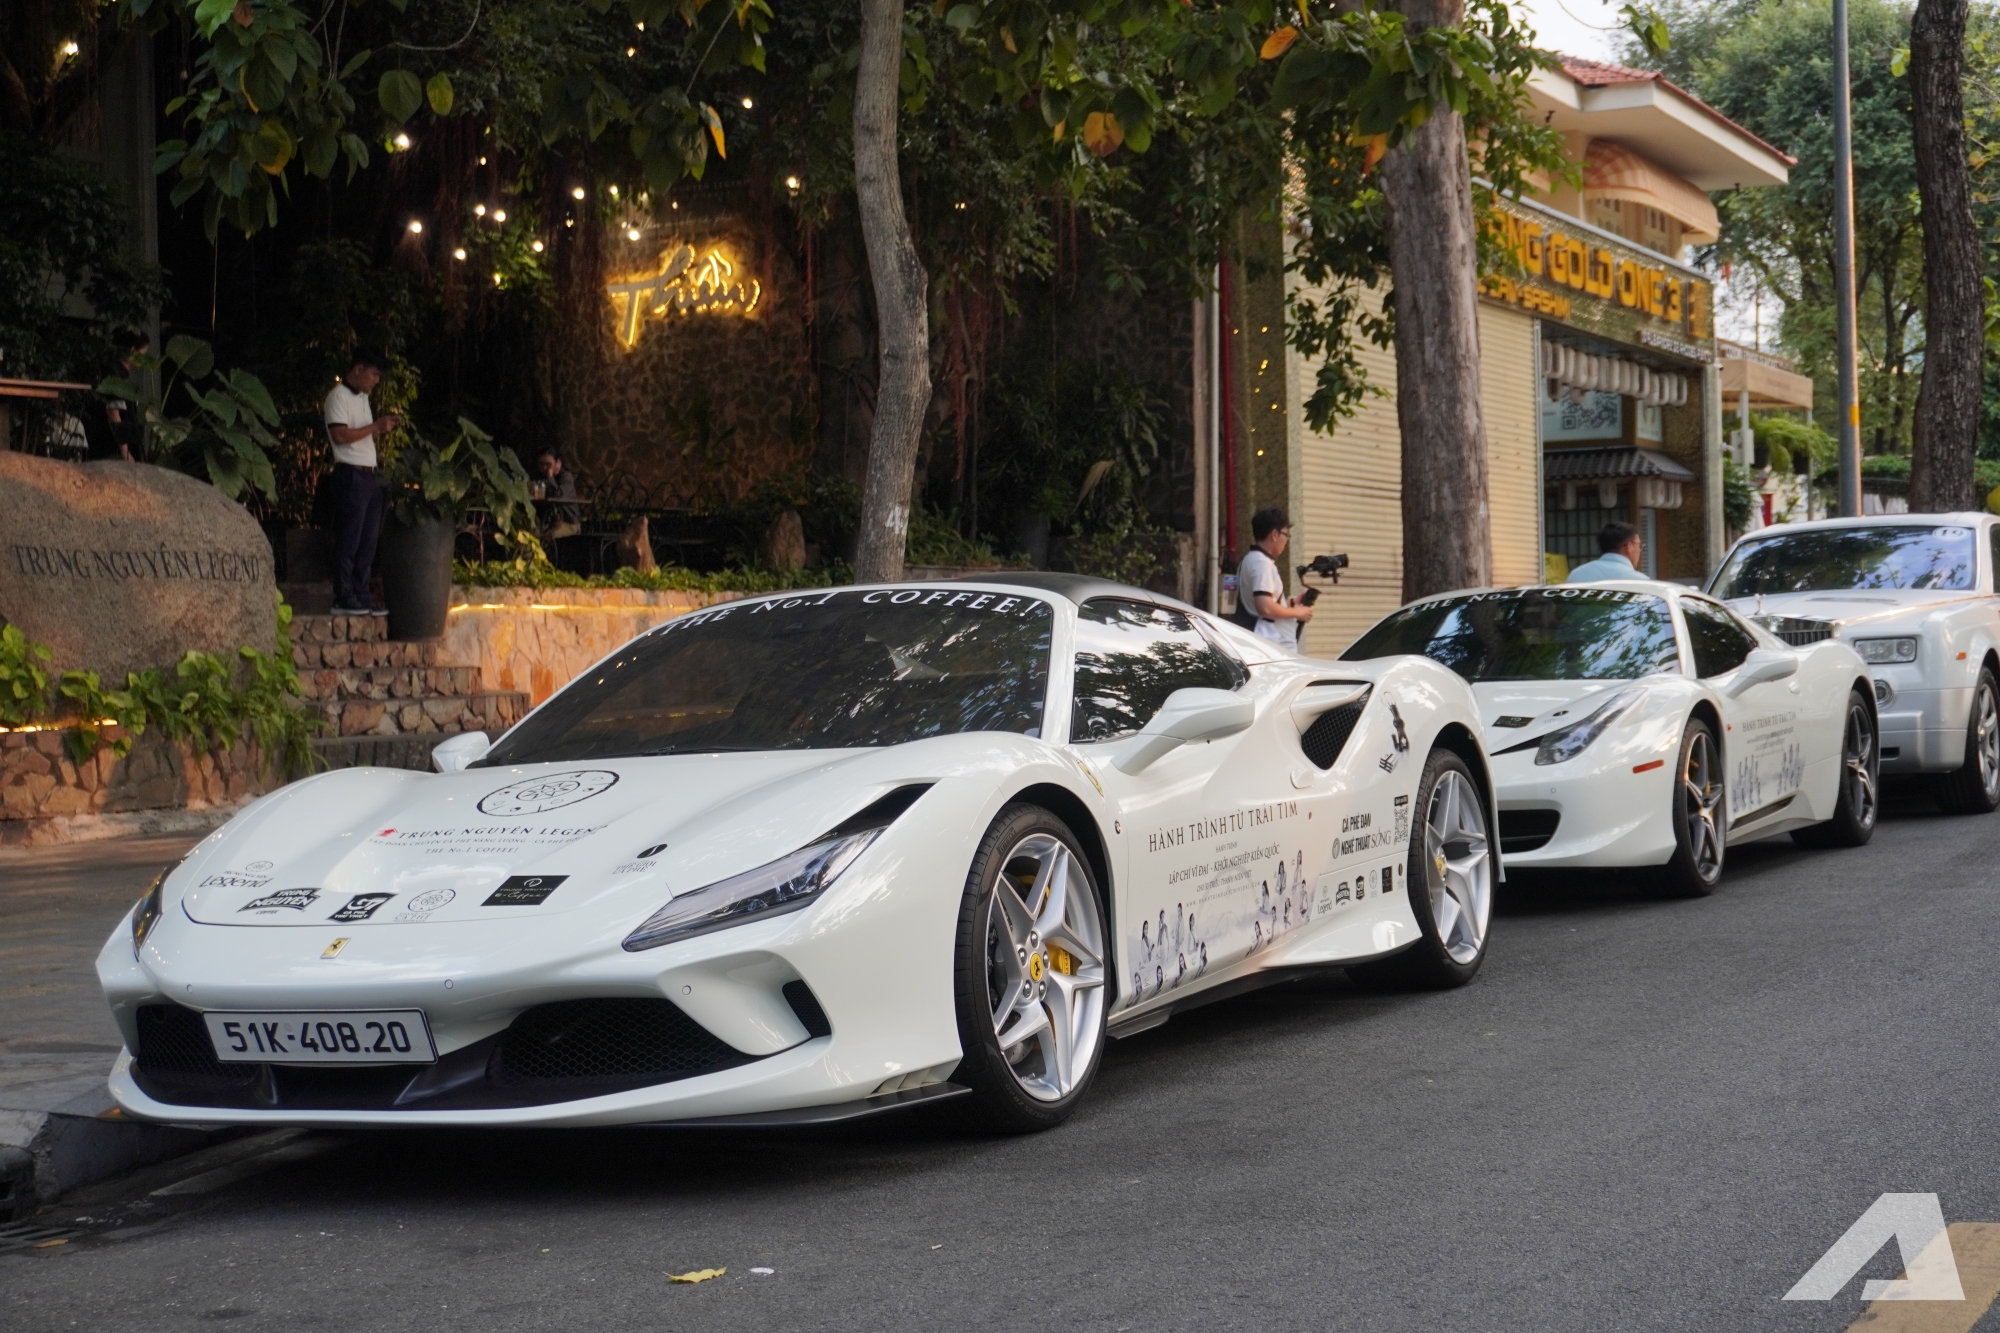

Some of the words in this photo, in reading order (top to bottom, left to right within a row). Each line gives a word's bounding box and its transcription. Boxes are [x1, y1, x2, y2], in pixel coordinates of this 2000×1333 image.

[1547, 233, 1613, 300] GOLD
[1618, 260, 1665, 317] ONE
[1522, 286, 1571, 319] SASHIMI
[11, 543, 91, 579] TRUNG
[92, 542, 192, 583] NGUYÊN
[194, 550, 260, 583] LEGEND
[1467, 589, 1527, 603] No.1
[660, 607, 738, 636] THE
[750, 592, 838, 615] No.1
[862, 589, 1042, 617] COFFEE!
[398, 829, 456, 839] TRUNG
[460, 826, 534, 836] NGUYÊN
[1149, 827, 1185, 852] HÀNH
[1189, 815, 1228, 842] TRÌNH
[1228, 809, 1244, 837] TỪ
[1248, 804, 1273, 828] TRÁI
[1276, 800, 1299, 820] TIM
[475, 846, 519, 854] COFFEE!
[198, 875, 274, 888] Legend
[277, 889, 314, 897] TRUNG
[222, 1021, 412, 1053] 51K-408.20
